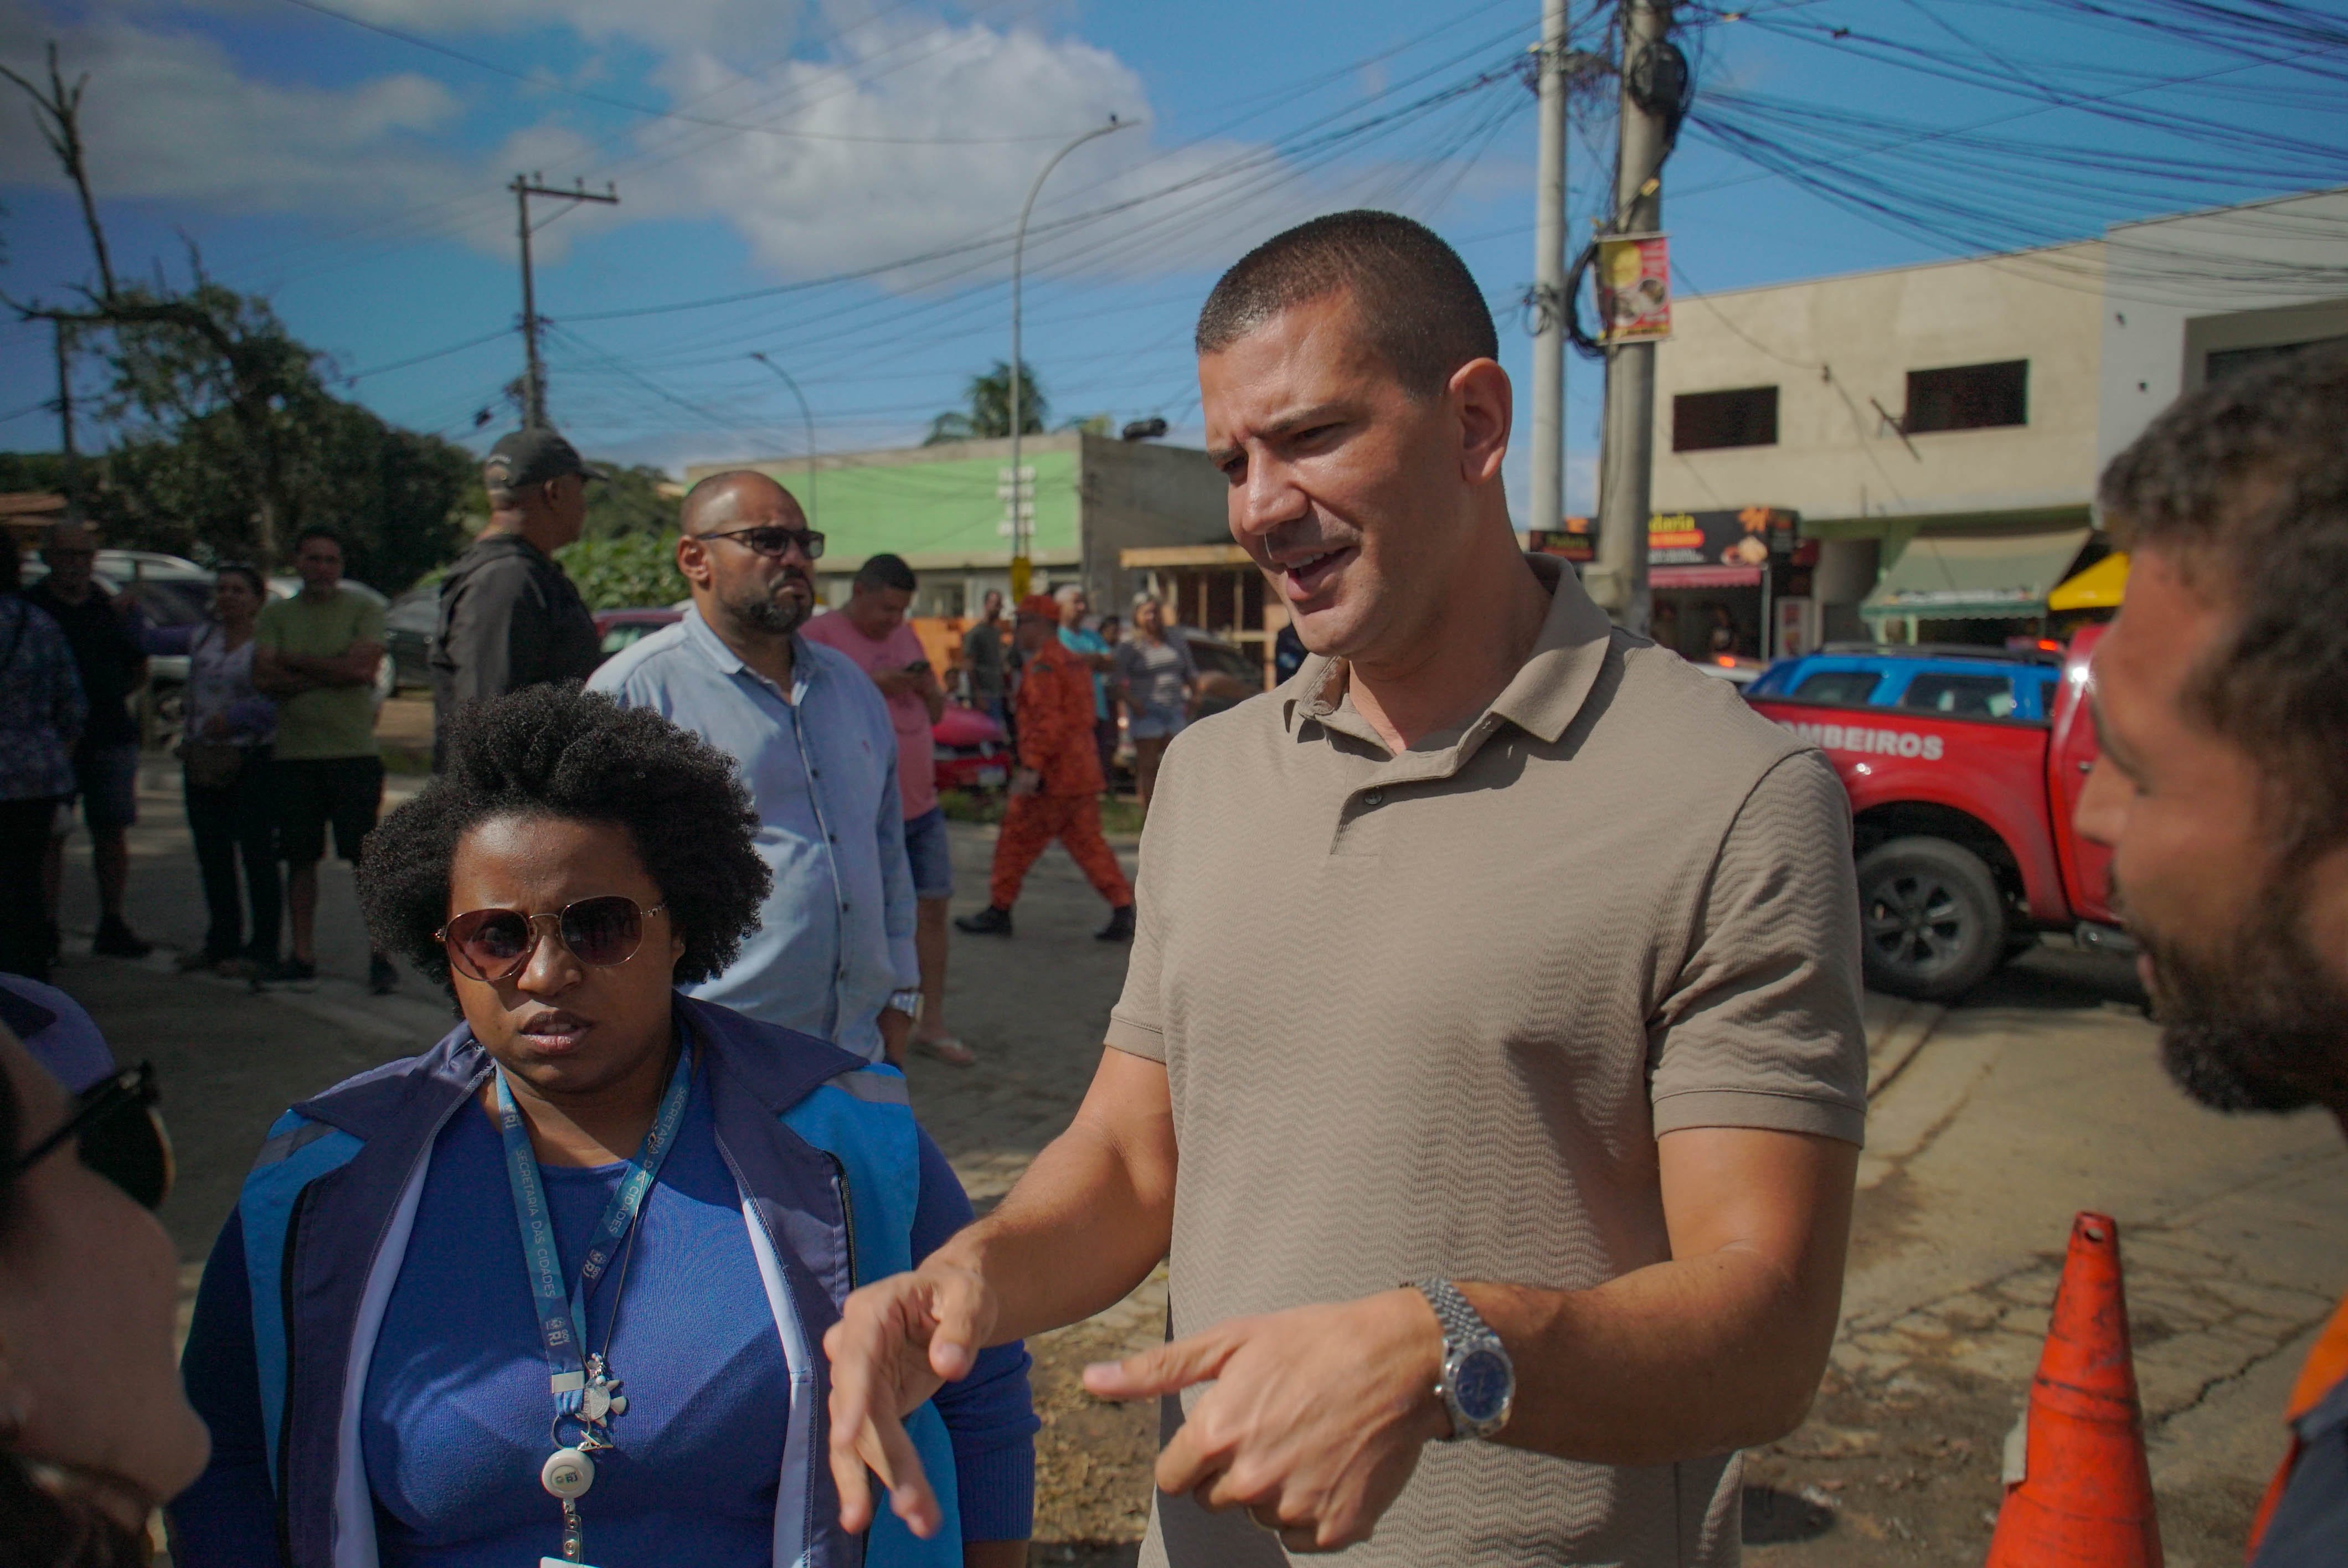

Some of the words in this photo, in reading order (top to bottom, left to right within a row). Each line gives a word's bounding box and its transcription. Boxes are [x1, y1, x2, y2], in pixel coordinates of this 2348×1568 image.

[1649, 513, 1695, 532] daria
[1777, 721, 1944, 760] MBEIROS
[650, 1086, 687, 1155] SECRETARIA
[516, 1149, 539, 1216] SECRETARIA
[609, 1186, 639, 1234] CIDADES
[532, 1221, 545, 1244] DAS
[537, 1249, 555, 1298] CIDADES
[583, 1260, 596, 1277] RJ
[548, 1330, 563, 1347] RJ
[562, 1329, 570, 1343] GOV
